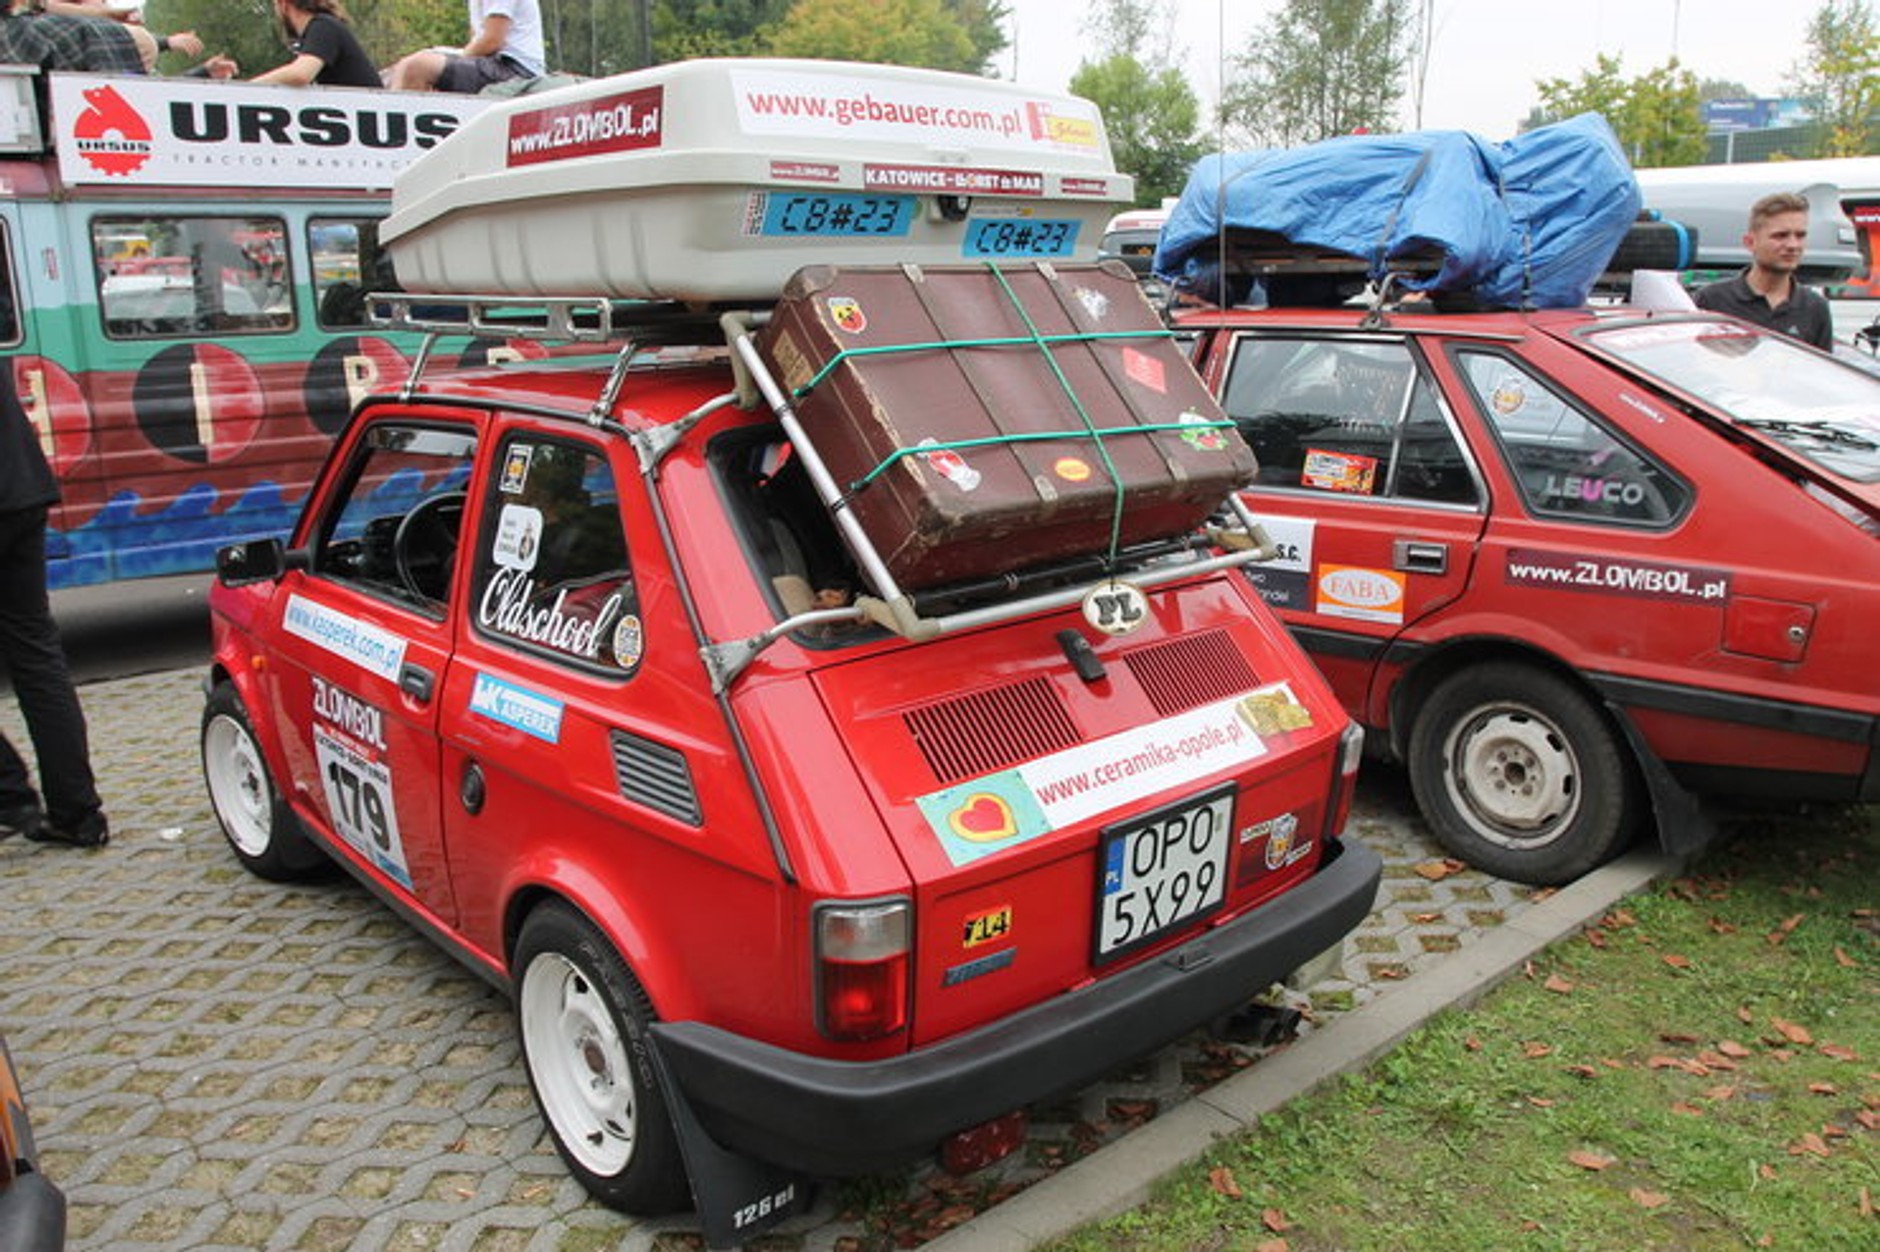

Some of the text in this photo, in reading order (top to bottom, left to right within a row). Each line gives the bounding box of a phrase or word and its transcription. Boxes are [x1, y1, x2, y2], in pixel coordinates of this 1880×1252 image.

[168, 102, 460, 150] URSUS
[747, 91, 1022, 138] www.gebauer.com.pl
[174, 154, 277, 166] TRACTOR
[782, 198, 900, 232] CB#23
[976, 223, 1070, 253] CB#23
[1546, 474, 1643, 505] LEUCO
[1093, 592, 1142, 626] PL
[1331, 577, 1389, 601] FABA
[479, 566, 622, 656] Oldschool
[1036, 717, 1244, 806] www.ceramika-opole.pl
[328, 761, 390, 851] 179
[1132, 805, 1214, 877] OPO
[1113, 860, 1216, 945] 5X99
[734, 1195, 771, 1229] 126
